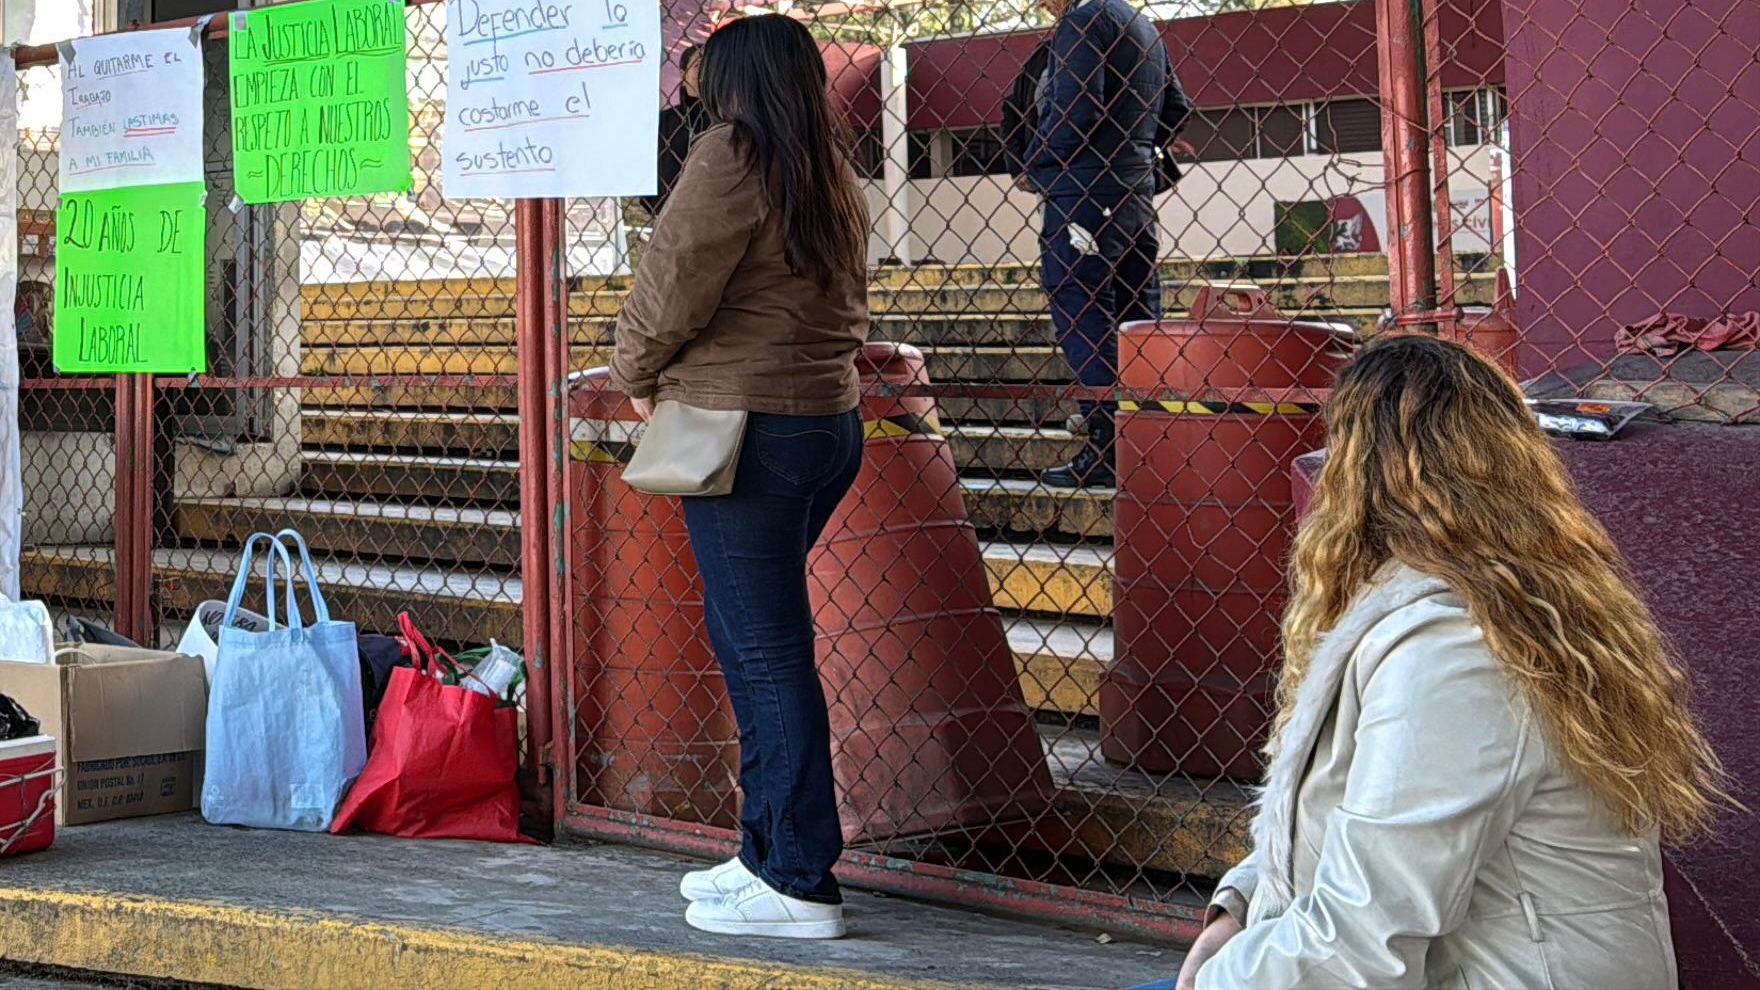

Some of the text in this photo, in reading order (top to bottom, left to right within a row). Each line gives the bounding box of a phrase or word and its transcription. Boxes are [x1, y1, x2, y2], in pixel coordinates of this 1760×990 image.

[234, 2, 402, 60] LA JUSTICIA LABORAL
[68, 51, 182, 80] AL QUITARME EL
[233, 61, 364, 109] EMPIEZA CON EL
[460, 54, 509, 90] justo
[524, 50, 555, 68] no
[123, 112, 180, 131] LASTIMAS
[234, 97, 391, 152] RESPETO A NUESTROS
[458, 81, 592, 127] costarme el
[68, 145, 154, 171] A MI FAMILIA
[266, 147, 358, 198] DERECHOS
[456, 136, 553, 171] sustento
[63, 199, 184, 254] 20 AÑOS DE
[63, 266, 145, 311] INJUSTICIA
[78, 316, 149, 365] LABORAL
